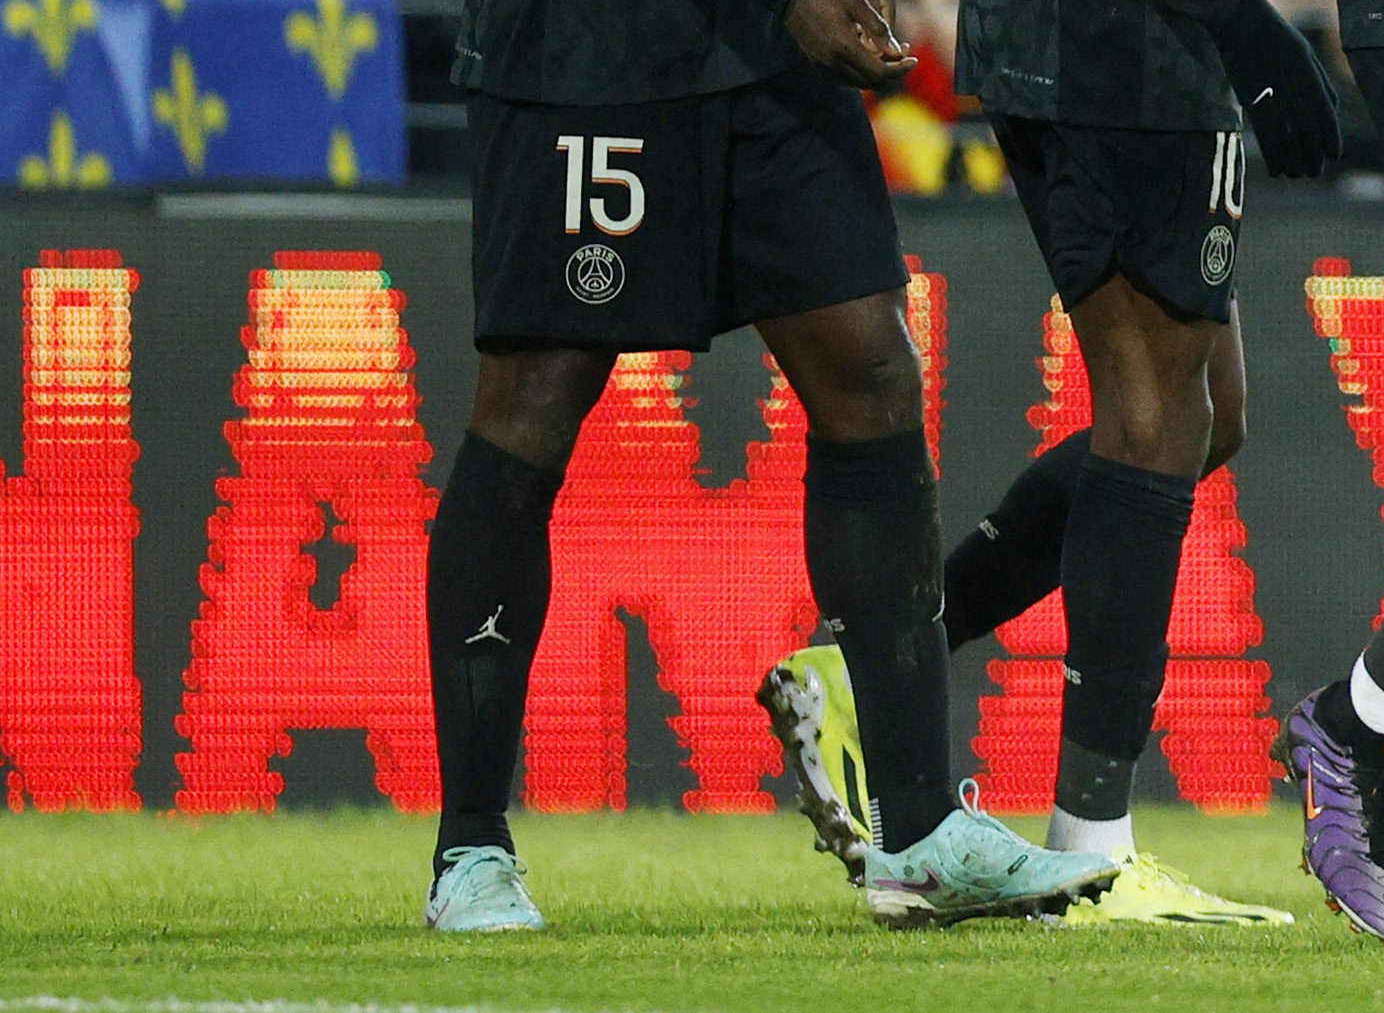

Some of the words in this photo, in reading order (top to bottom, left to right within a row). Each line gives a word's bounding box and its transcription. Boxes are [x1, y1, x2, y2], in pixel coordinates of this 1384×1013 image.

[556, 135, 645, 236] 15
[1208, 131, 1246, 220] 10
[576, 247, 615, 263] PARIS
